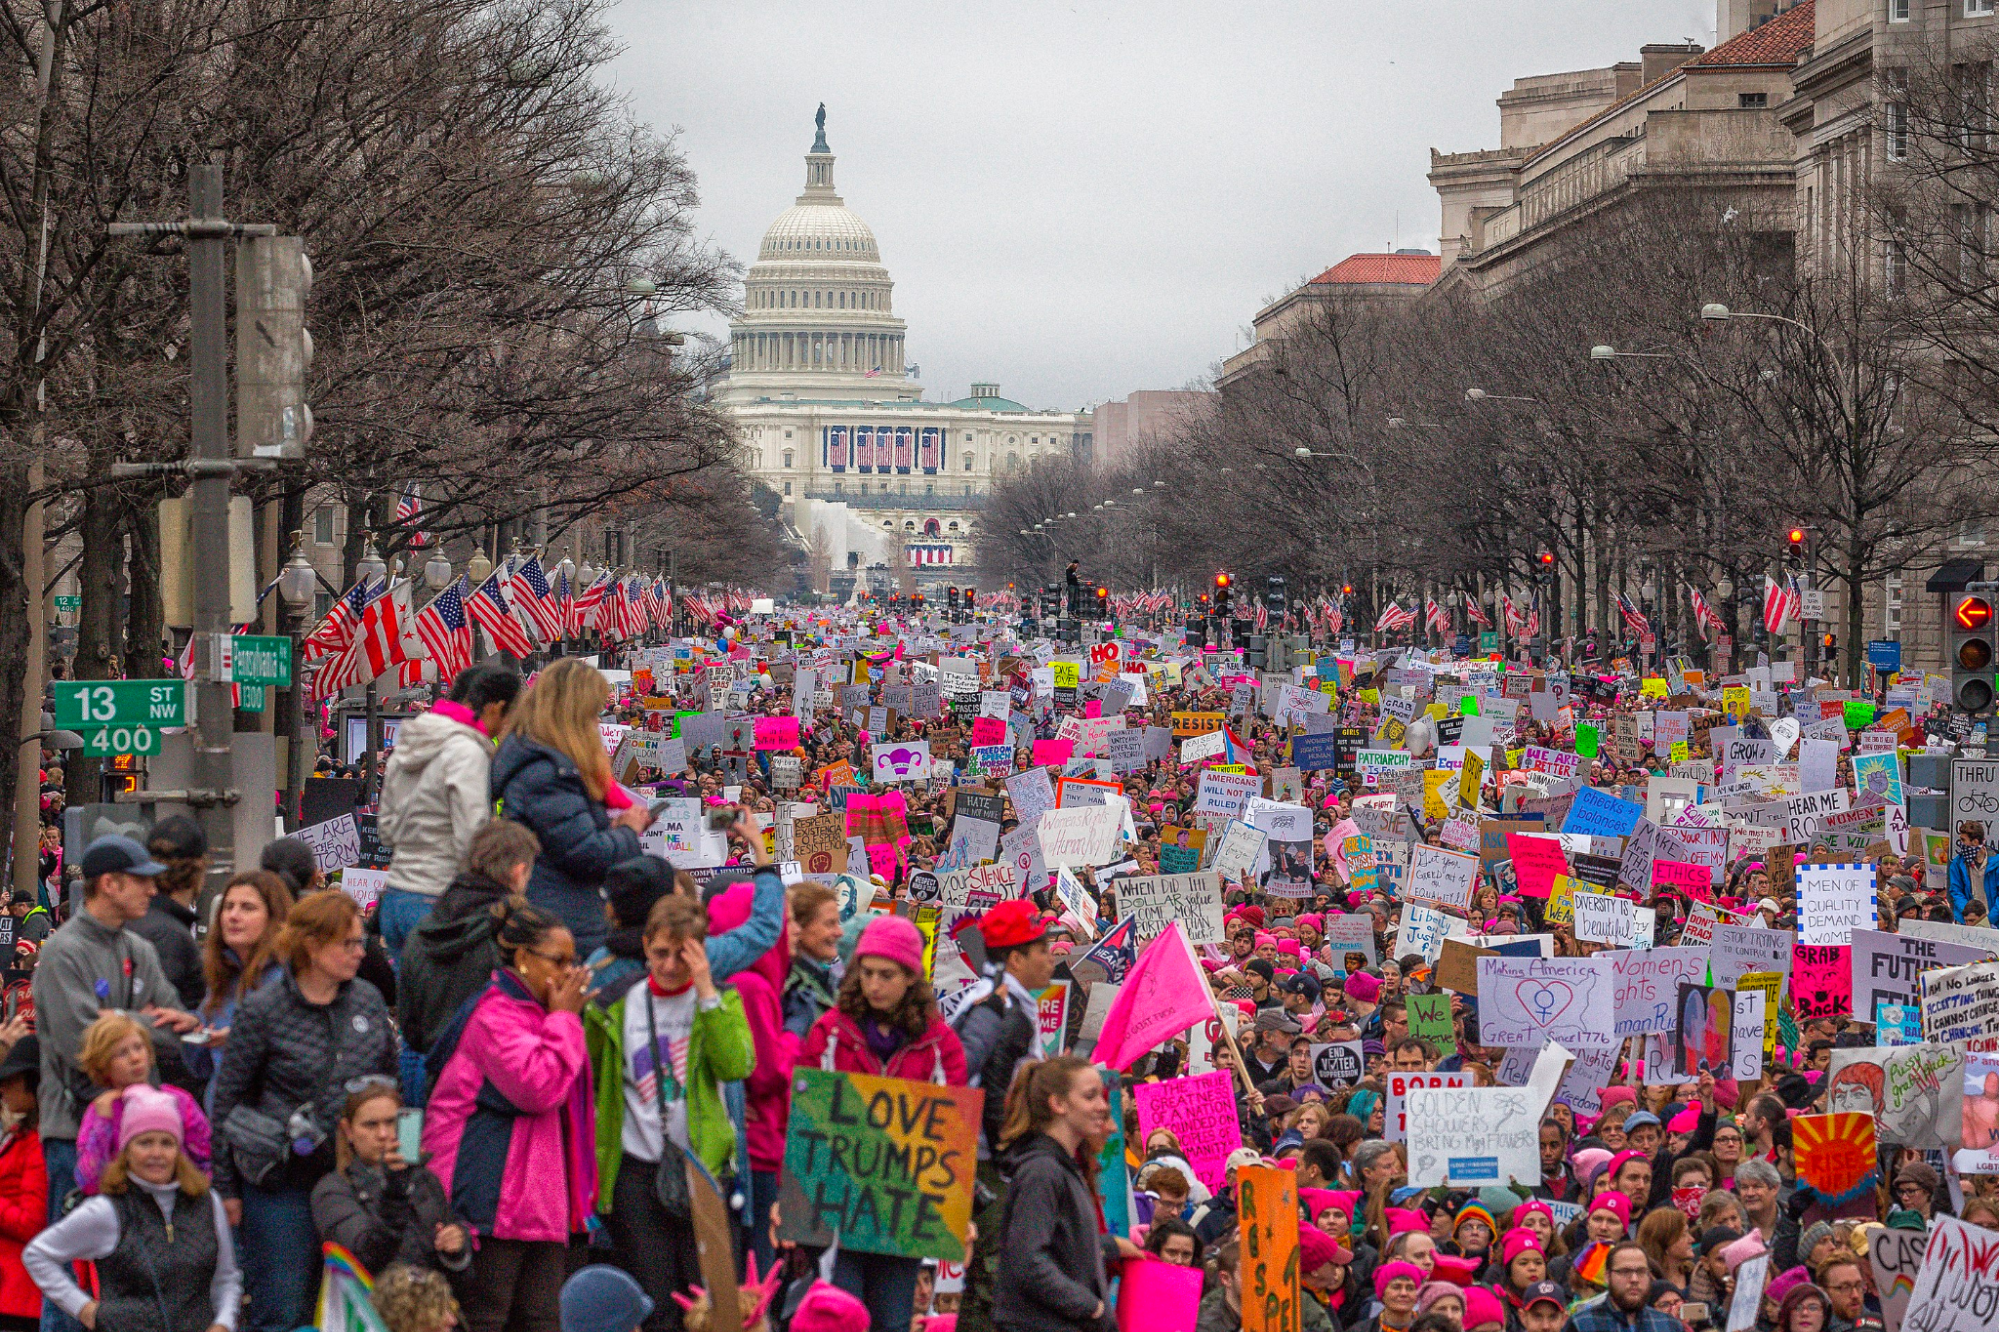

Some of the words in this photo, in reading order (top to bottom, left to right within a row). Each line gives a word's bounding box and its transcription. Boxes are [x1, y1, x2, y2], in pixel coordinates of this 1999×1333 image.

[73, 688, 116, 721] 13
[150, 687, 173, 702] ST
[150, 704, 176, 719] NW
[1172, 717, 1225, 731] RESIST
[1656, 726, 1686, 735] FUTURE
[1663, 719, 1680, 727] THE
[92, 728, 152, 752] 400
[631, 741, 658, 750] OMEN
[1110, 743, 1141, 753] DIVERSITY
[976, 746, 1012, 756] FREEDOM
[1358, 752, 1411, 766] PATRIARCHY
[1526, 748, 1549, 761] WE
[1555, 753, 1579, 766] ARE
[980, 760, 1012, 768] WORSHIP
[1367, 765, 1378, 774] Is
[1534, 760, 1571, 777] BETTER
[1206, 773, 1257, 787] AMERICANS
[1957, 766, 1995, 783] THRU
[1204, 786, 1224, 795] WILL
[1226, 787, 1243, 797] NOT
[967, 796, 990, 809] HATE
[1207, 798, 1237, 809] RULED
[1583, 791, 1624, 814] checks
[1786, 795, 1818, 816] HEAR
[1820, 792, 1840, 812] ME
[795, 816, 831, 829] RESPETA
[833, 813, 845, 824] MI
[1380, 810, 1409, 835] SHE
[1577, 807, 1628, 833] balances
[1826, 808, 1875, 827] WOMEN
[1892, 807, 1904, 822] A
[322, 815, 354, 841] ARE
[795, 826, 842, 838] EXISTENCIA
[1733, 826, 1747, 836] We
[1701, 828, 1730, 847] TINY
[313, 841, 335, 855] THE
[314, 840, 361, 871] TORM
[794, 840, 847, 856] RESISTENCIA
[1690, 852, 1710, 865] OFF
[1710, 850, 1725, 867] MY
[1656, 863, 1707, 882] ETHICS
[346, 877, 368, 887] HEAR
[1117, 879, 1155, 897] WHEN
[1161, 877, 1180, 895] DID
[1188, 877, 1209, 892] THE
[1808, 879, 1842, 892] MEN
[1844, 879, 1860, 892] OF
[1118, 893, 1184, 909] DOLLAR
[1574, 894, 1617, 914] DIVERSITY
[1620, 900, 1629, 916] IS
[1807, 899, 1861, 913] QUALITY
[1409, 905, 1451, 936] Liberty
[1582, 911, 1634, 945] beautiful
[1808, 914, 1862, 928] DEMAND
[1722, 930, 1747, 944] STOP
[1749, 932, 1786, 948] TRYING
[1900, 938, 1937, 957] THE
[1735, 947, 1767, 958] CONTROL
[1794, 945, 1840, 965] GRAB
[1485, 959, 1526, 979] Making
[1528, 961, 1601, 978] America
[1946, 978, 1963, 991] NO
[1965, 972, 1997, 986] LONGER
[1413, 1000, 1446, 1024] We
[1796, 994, 1849, 1019] BACK
[1926, 993, 1975, 1015] ACCEPTING
[1934, 1009, 1970, 1029] CANNOT
[1411, 1029, 1454, 1044] deserve
[1481, 1022, 1538, 1044] GREAT
[1547, 1030, 1576, 1044] Since
[1576, 1031, 1611, 1045] 1776
[1940, 1023, 1983, 1043] CHANGING
[1328, 1046, 1346, 1058] END
[1162, 1083, 1189, 1094] THE
[1192, 1075, 1227, 1090] TRUE
[1149, 1088, 1229, 1113] GREATNESS
[1409, 1091, 1483, 1117] GOLDEN
[829, 1079, 957, 1142] LOVE
[1151, 1111, 1168, 1125] OF
[1171, 1108, 1185, 1122] A
[1187, 1100, 1232, 1120] NATION
[1161, 1116, 1218, 1135] FOUNDED
[1219, 1114, 1235, 1127] ON
[1411, 1115, 1490, 1137] SHOWERS
[1412, 1133, 1461, 1151] BRING
[795, 1129, 961, 1190] TRUMPS
[810, 1181, 946, 1241] HATE
